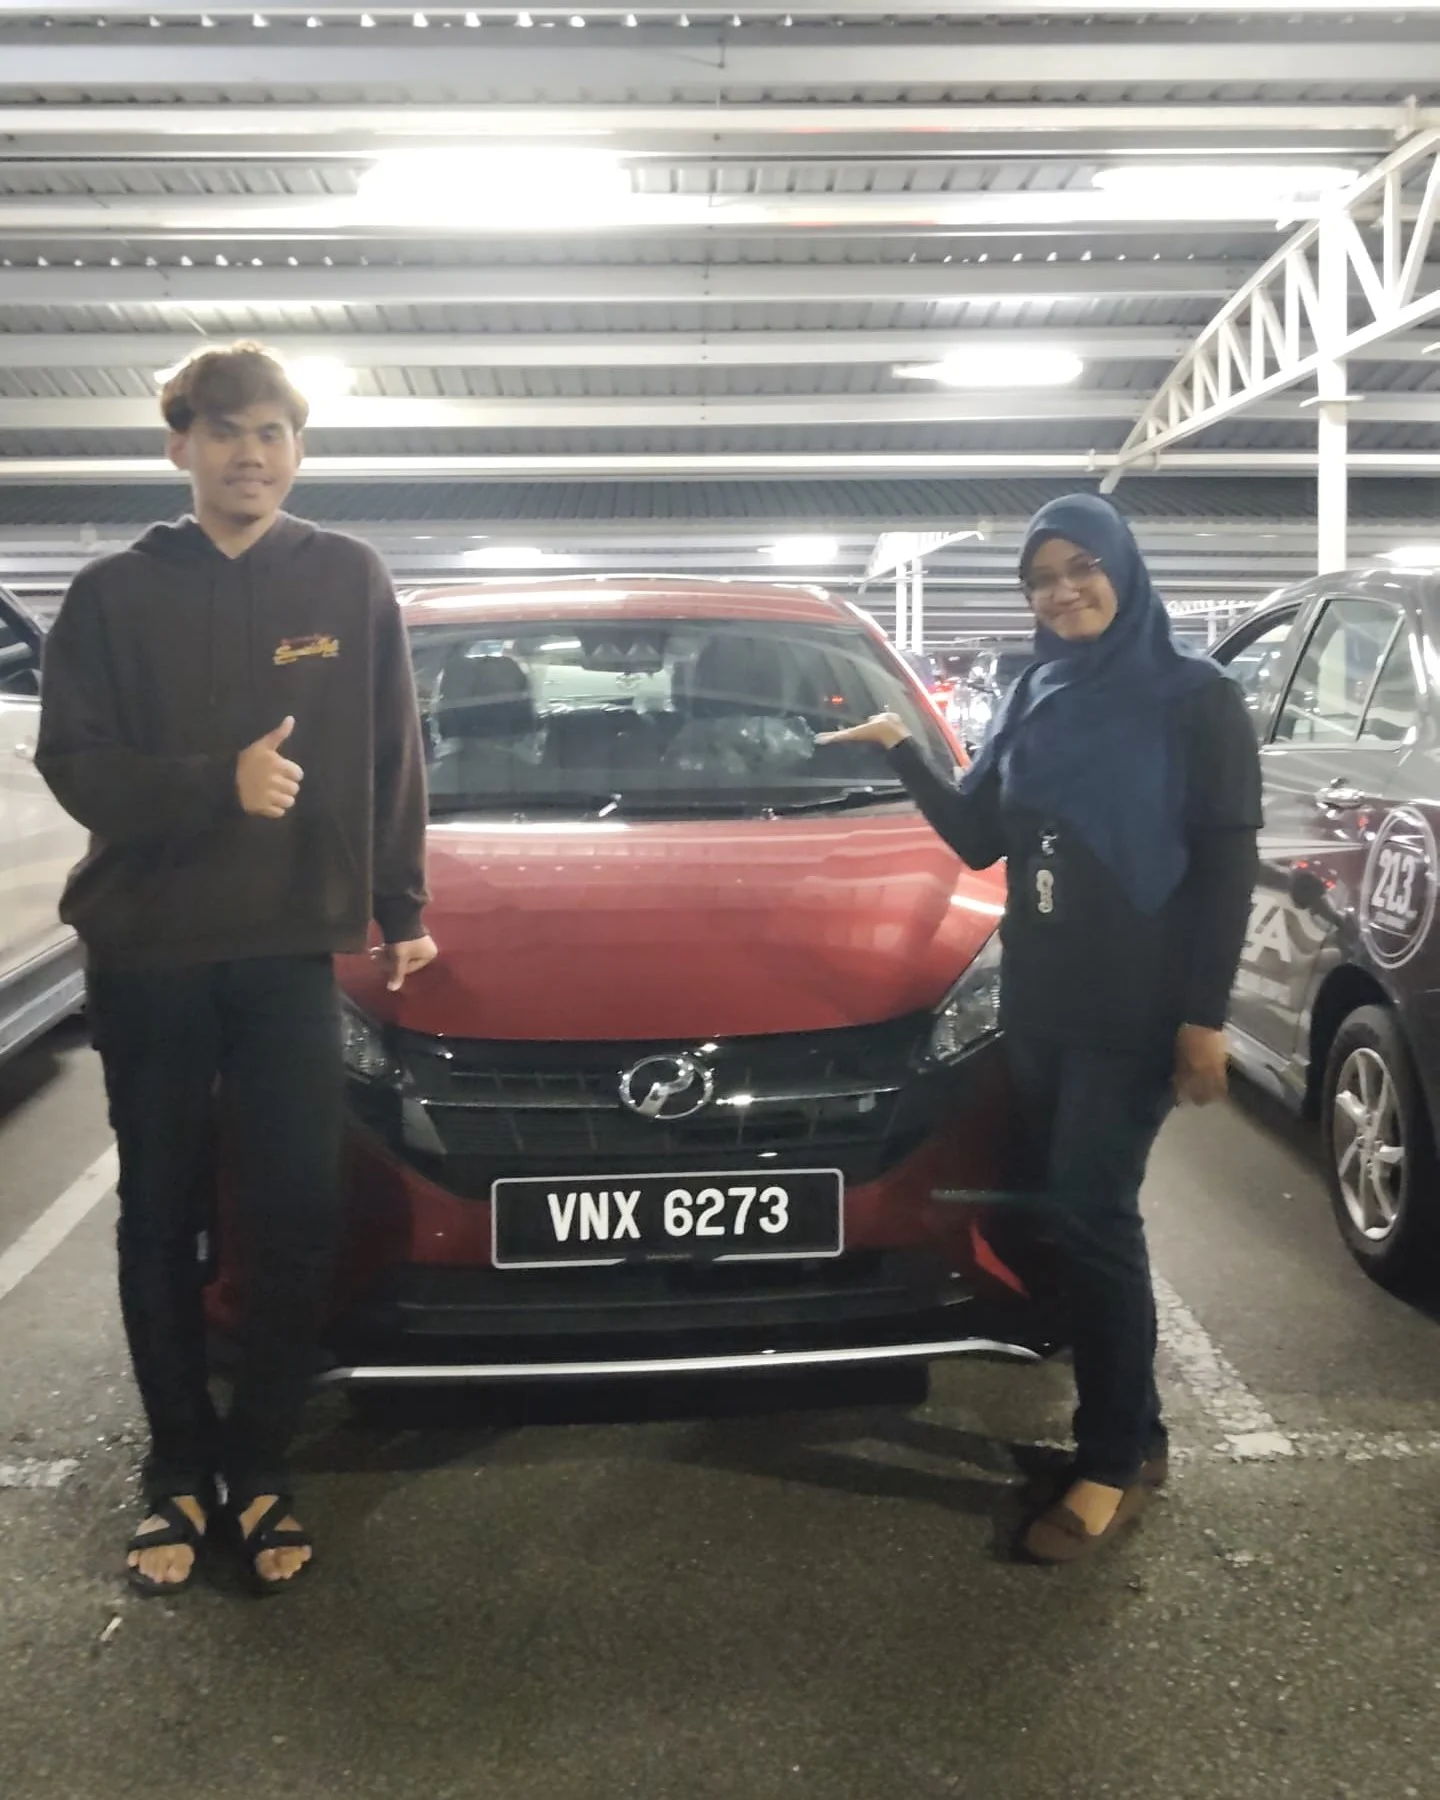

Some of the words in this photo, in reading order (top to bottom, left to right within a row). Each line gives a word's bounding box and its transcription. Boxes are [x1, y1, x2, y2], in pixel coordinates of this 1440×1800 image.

[1371, 848, 1416, 914] 213
[547, 1191, 642, 1241] VNX
[664, 1187, 789, 1236] 6273
